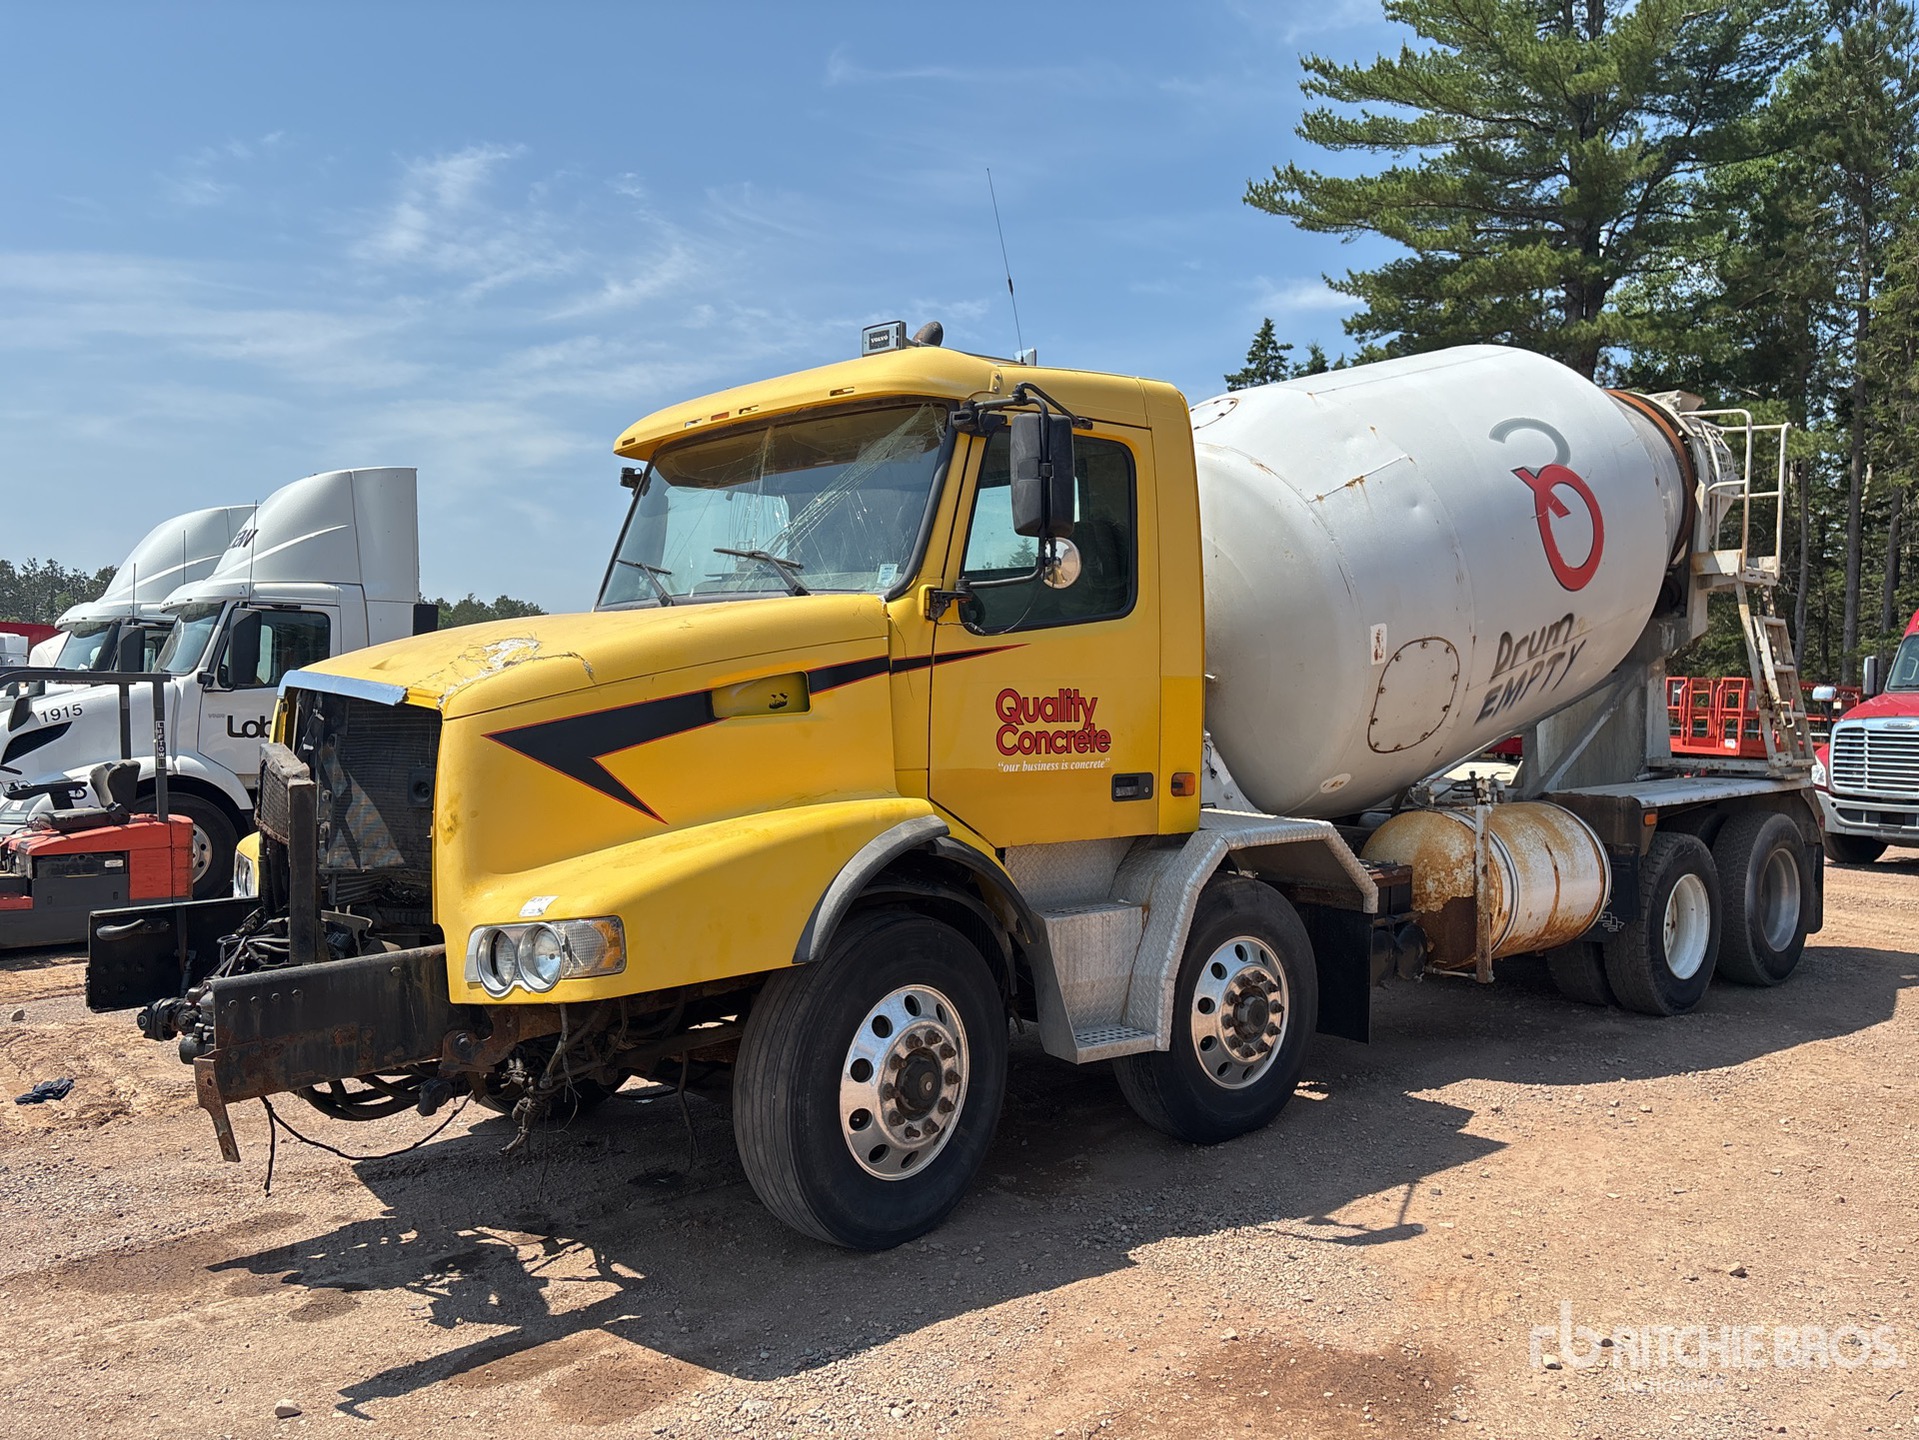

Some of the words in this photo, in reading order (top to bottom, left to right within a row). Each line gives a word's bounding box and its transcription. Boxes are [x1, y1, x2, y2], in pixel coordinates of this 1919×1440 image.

[871, 335, 888, 343] VOLVO
[40, 704, 83, 723] 1915
[995, 688, 1098, 728] Quality
[996, 723, 1111, 756] Concrete
[1022, 761, 1059, 772] business
[1061, 760, 1069, 769] is
